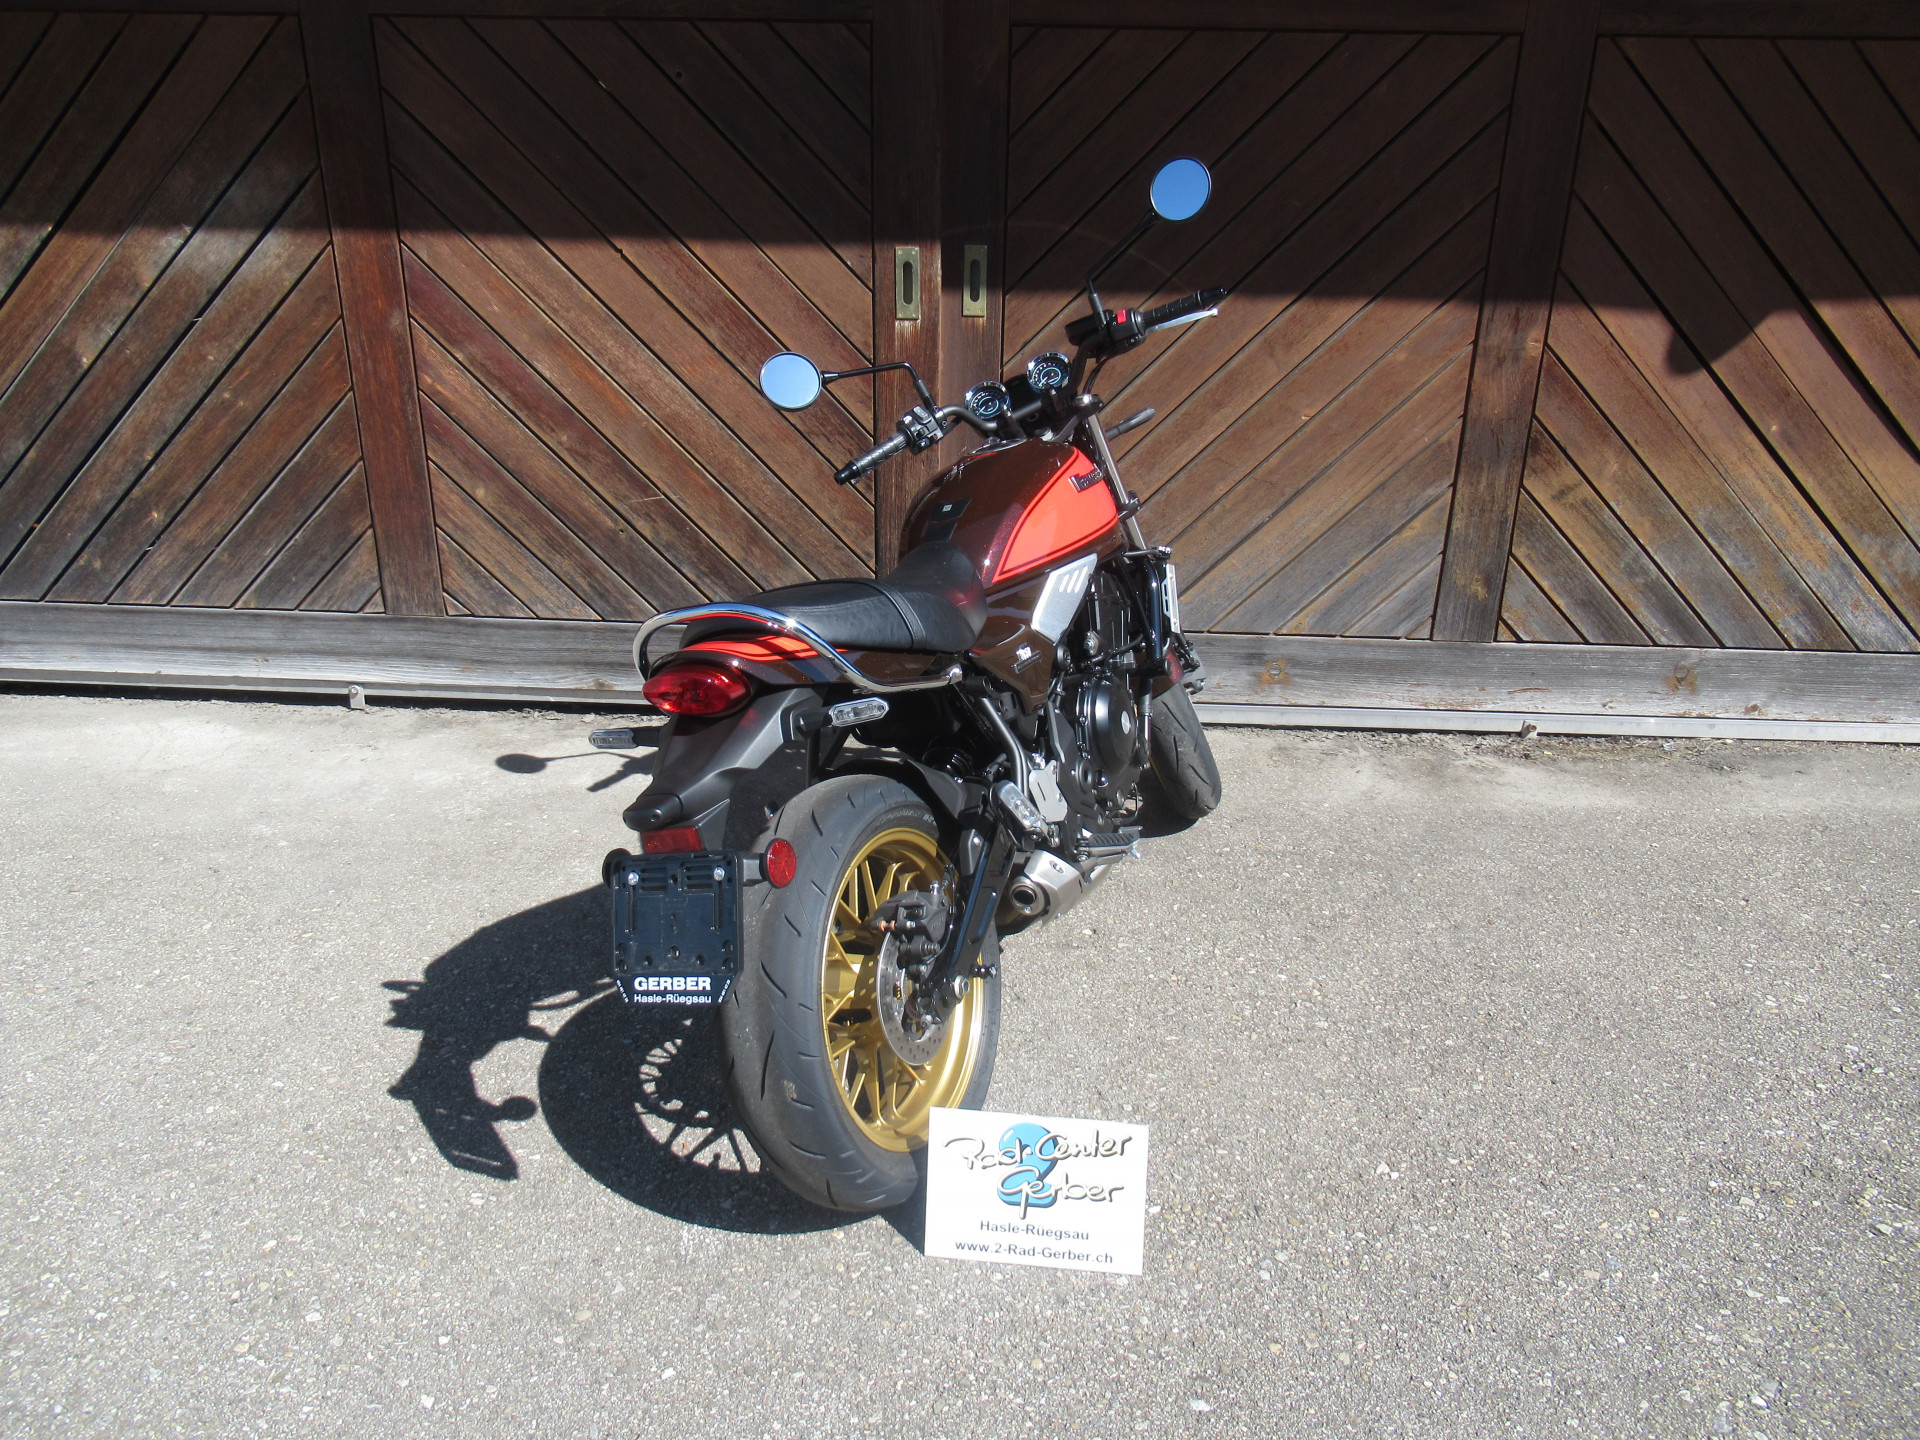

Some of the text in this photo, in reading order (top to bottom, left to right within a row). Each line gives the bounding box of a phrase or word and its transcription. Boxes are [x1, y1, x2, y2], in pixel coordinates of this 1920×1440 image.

[634, 977, 711, 991] GERBER
[634, 993, 712, 1005] Hasle-Rüegsau
[1034, 1129, 1133, 1162] Center
[997, 1165, 1125, 1220] Gerber
[980, 1220, 1090, 1241] Hasle-Rüegsau
[955, 1241, 1114, 1264] www.2-Rad-Gerber.ch
